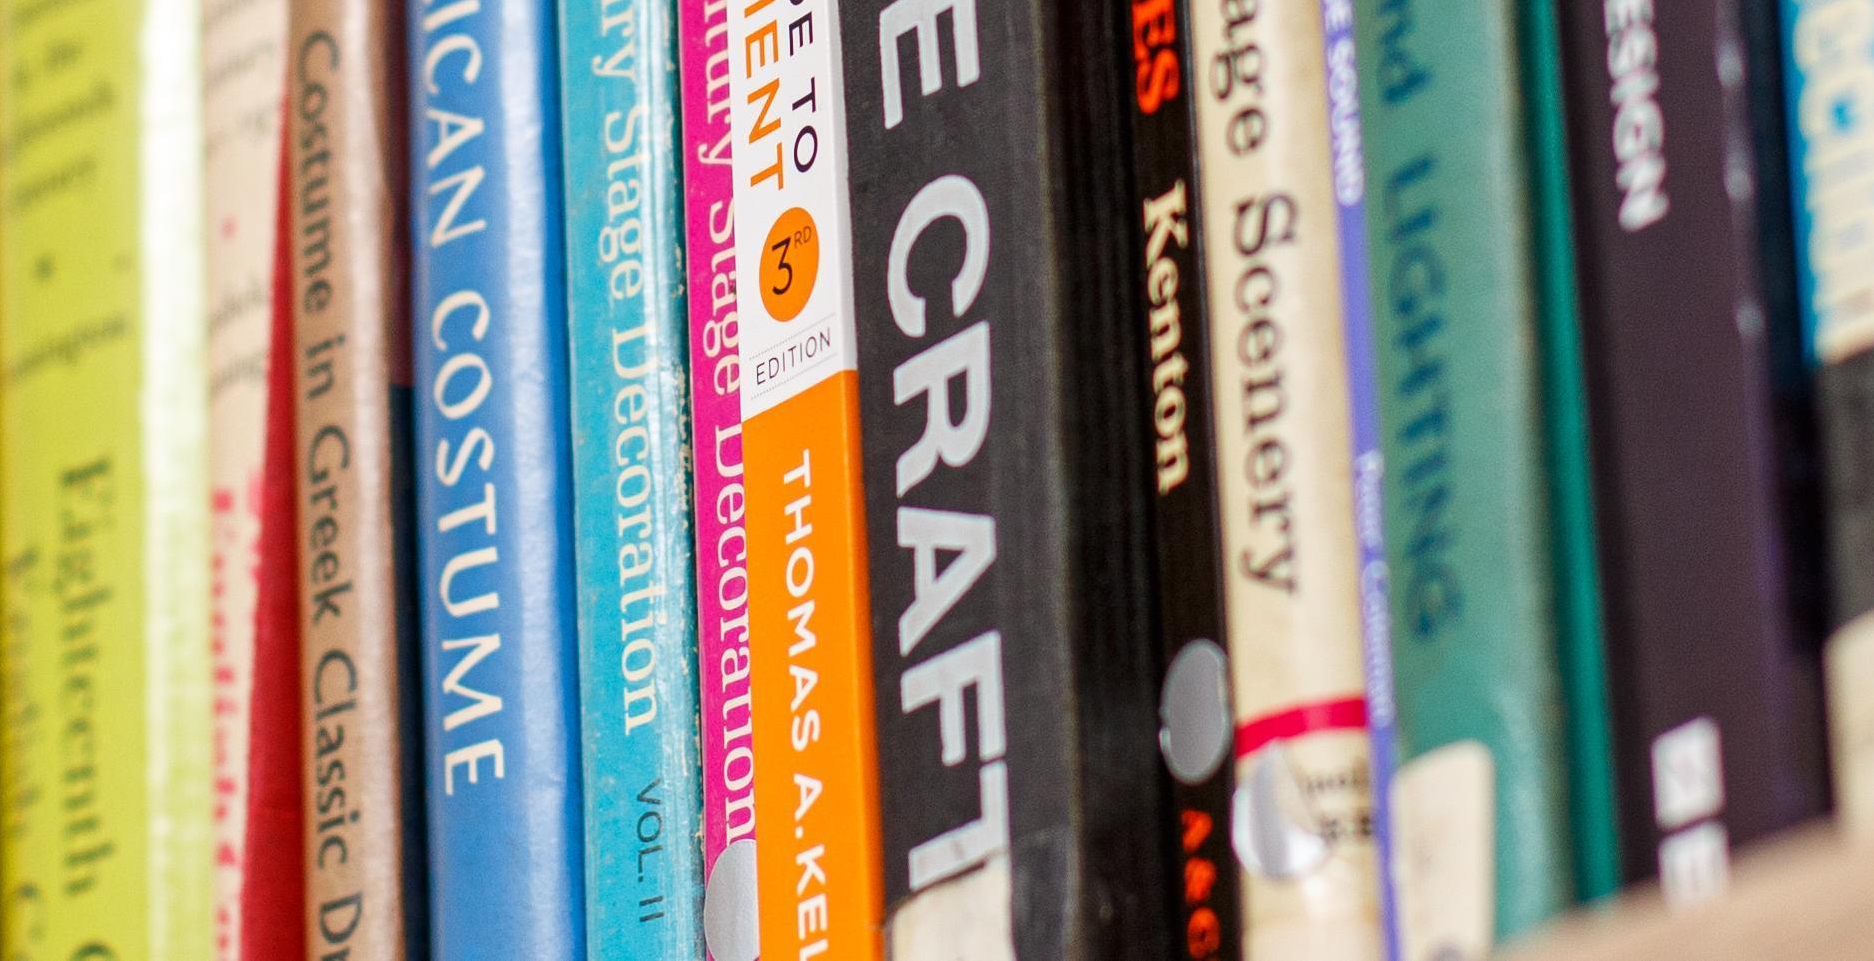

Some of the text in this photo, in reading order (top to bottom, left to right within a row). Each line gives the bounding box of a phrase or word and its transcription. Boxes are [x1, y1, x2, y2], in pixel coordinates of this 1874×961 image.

[297, 30, 340, 315] Costume
[597, 107, 648, 300] Stage
[791, 76, 819, 173] TO
[305, 333, 346, 401] in
[754, 326, 833, 387] EDITION
[1143, 178, 1190, 496] Kenton
[1232, 192, 1299, 598] Scenery
[1384, 155, 1465, 644] LIGHTING
[307, 425, 354, 624] Greek
[431, 289, 505, 797] COSTUME
[610, 324, 667, 737] Decoration
[783, 448, 822, 753] THOMAS
[886, 174, 1010, 891] CRAFT
[53, 456, 115, 897] Eighteenth
[313, 649, 361, 871] Classic
[635, 778, 665, 924] VOL. II
